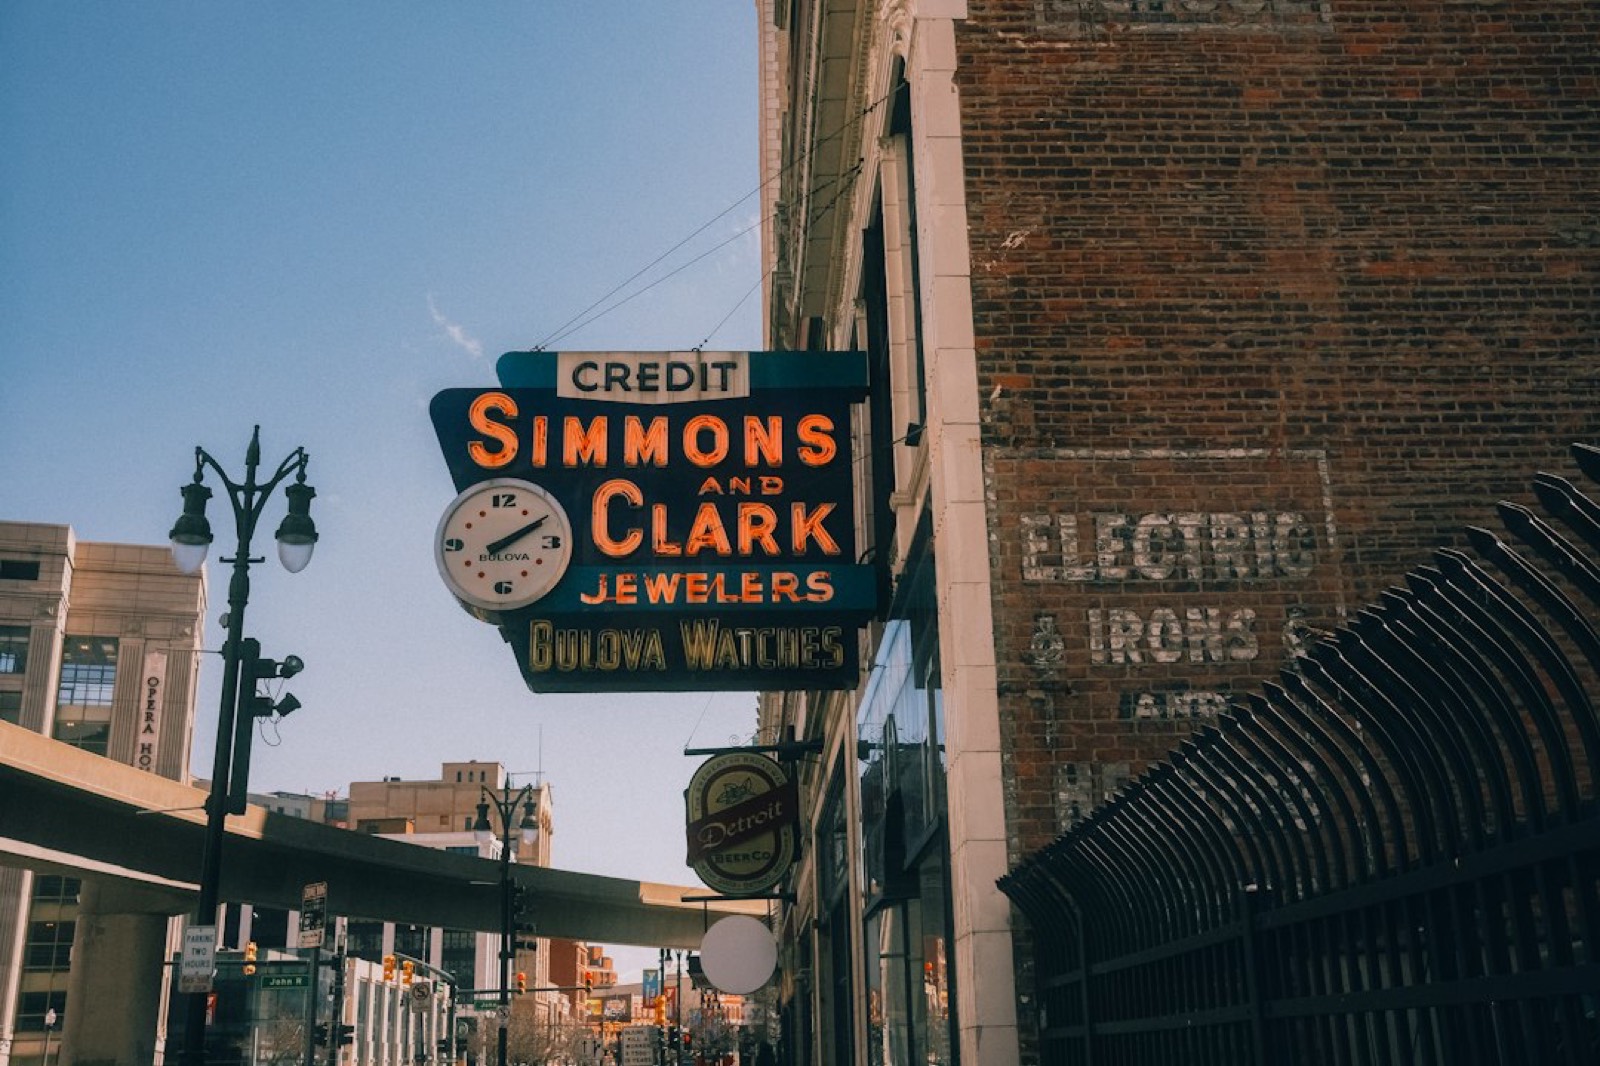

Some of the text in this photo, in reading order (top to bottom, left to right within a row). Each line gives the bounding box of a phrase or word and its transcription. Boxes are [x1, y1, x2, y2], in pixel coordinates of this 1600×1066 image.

[572, 361, 737, 391] CREDIT
[467, 392, 837, 468] SIMMONS
[697, 476, 784, 495] AND
[492, 494, 516, 508] 12
[591, 479, 841, 557] CLARK
[446, 539, 464, 552] 9
[542, 536, 561, 549] 3
[479, 553, 530, 562] BULOVA
[494, 582, 513, 595] 6
[580, 573, 835, 605] JEWELERS
[1088, 608, 1259, 664] IRONS
[528, 618, 844, 671] BULOVA WATCHES
[142, 677, 159, 733] OPERA
[697, 801, 783, 848] Detroit
[186, 935, 214, 943] PARKING
[191, 948, 207, 956] TWO
[185, 960, 210, 968] HOURS
[269, 978, 293, 986] John
